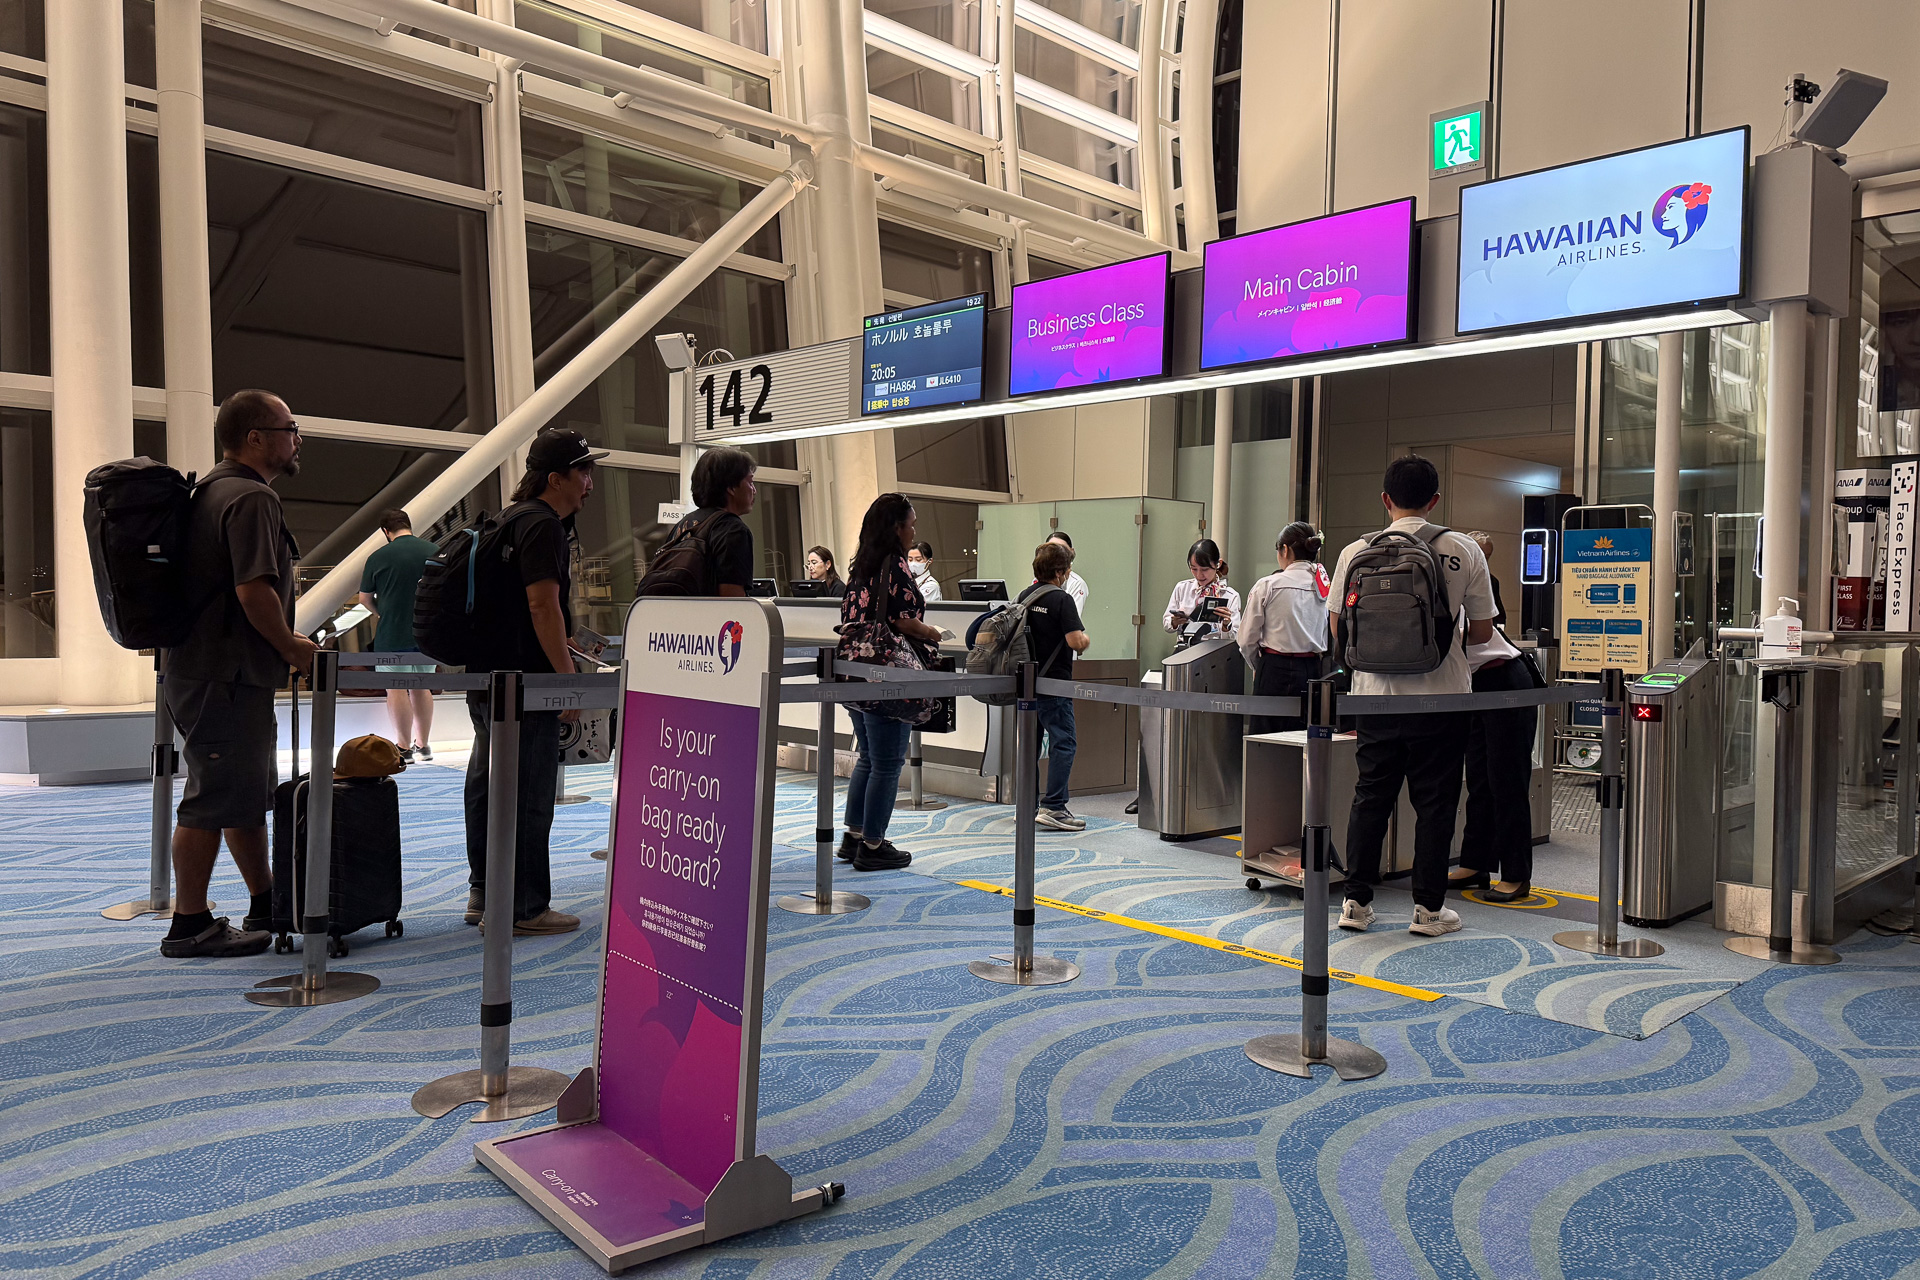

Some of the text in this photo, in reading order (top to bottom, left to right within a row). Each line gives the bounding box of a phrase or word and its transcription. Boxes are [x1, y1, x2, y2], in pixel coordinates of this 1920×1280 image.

[1483, 211, 1642, 261] HAWAIIAN
[1243, 261, 1358, 301] Main Cabin
[913, 319, 953, 339] 호놀룰루
[1027, 302, 1145, 338] Business Class
[871, 328, 908, 346] ホノルル
[871, 366, 896, 381] 20:05
[939, 374, 961, 386] JL6410
[699, 363, 774, 431] 142
[889, 379, 916, 393] HA864
[1836, 479, 1854, 487] ANA
[1868, 478, 1884, 487] ANA
[662, 511, 680, 519] PASS
[1577, 548, 1630, 558] Vietnam Airlines
[1891, 502, 1910, 616] Face Express
[648, 632, 715, 657] HAWAIIAN
[1215, 701, 1240, 711] TIAT
[659, 718, 716, 758] Is your
[649, 764, 720, 802] carry-on
[641, 795, 726, 854] bag ready
[640, 838, 721, 890] to board?
[1246, 949, 1279, 961] Please
[1280, 958, 1303, 967] wait
[541, 1169, 576, 1195] Carry-on
